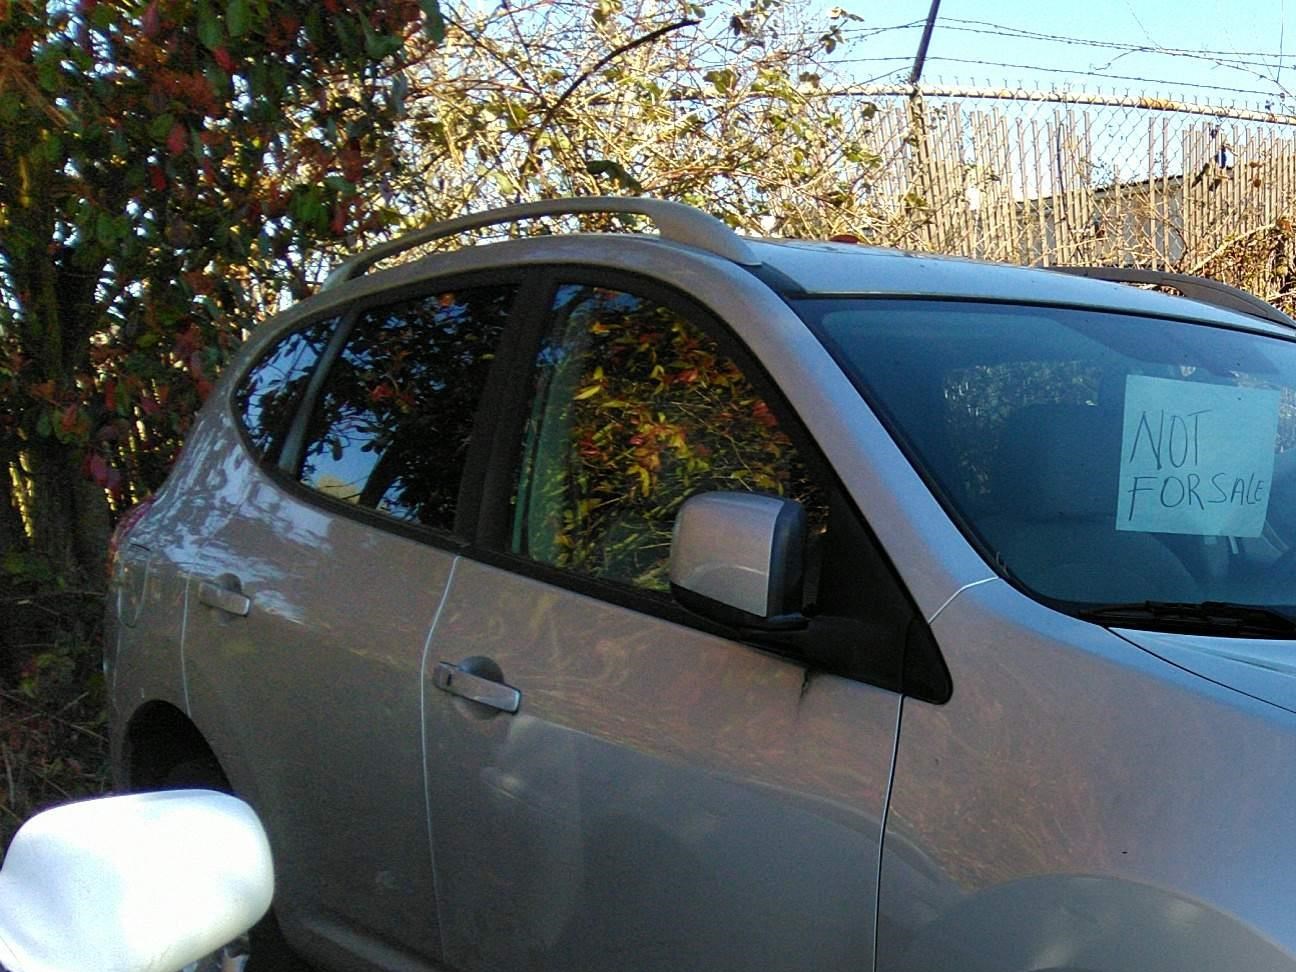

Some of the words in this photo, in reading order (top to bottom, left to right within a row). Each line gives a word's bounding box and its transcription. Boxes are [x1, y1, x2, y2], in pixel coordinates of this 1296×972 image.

[1128, 408, 1213, 471] NOT
[1127, 472, 1205, 522] FOR
[1207, 471, 1265, 506] SALE
